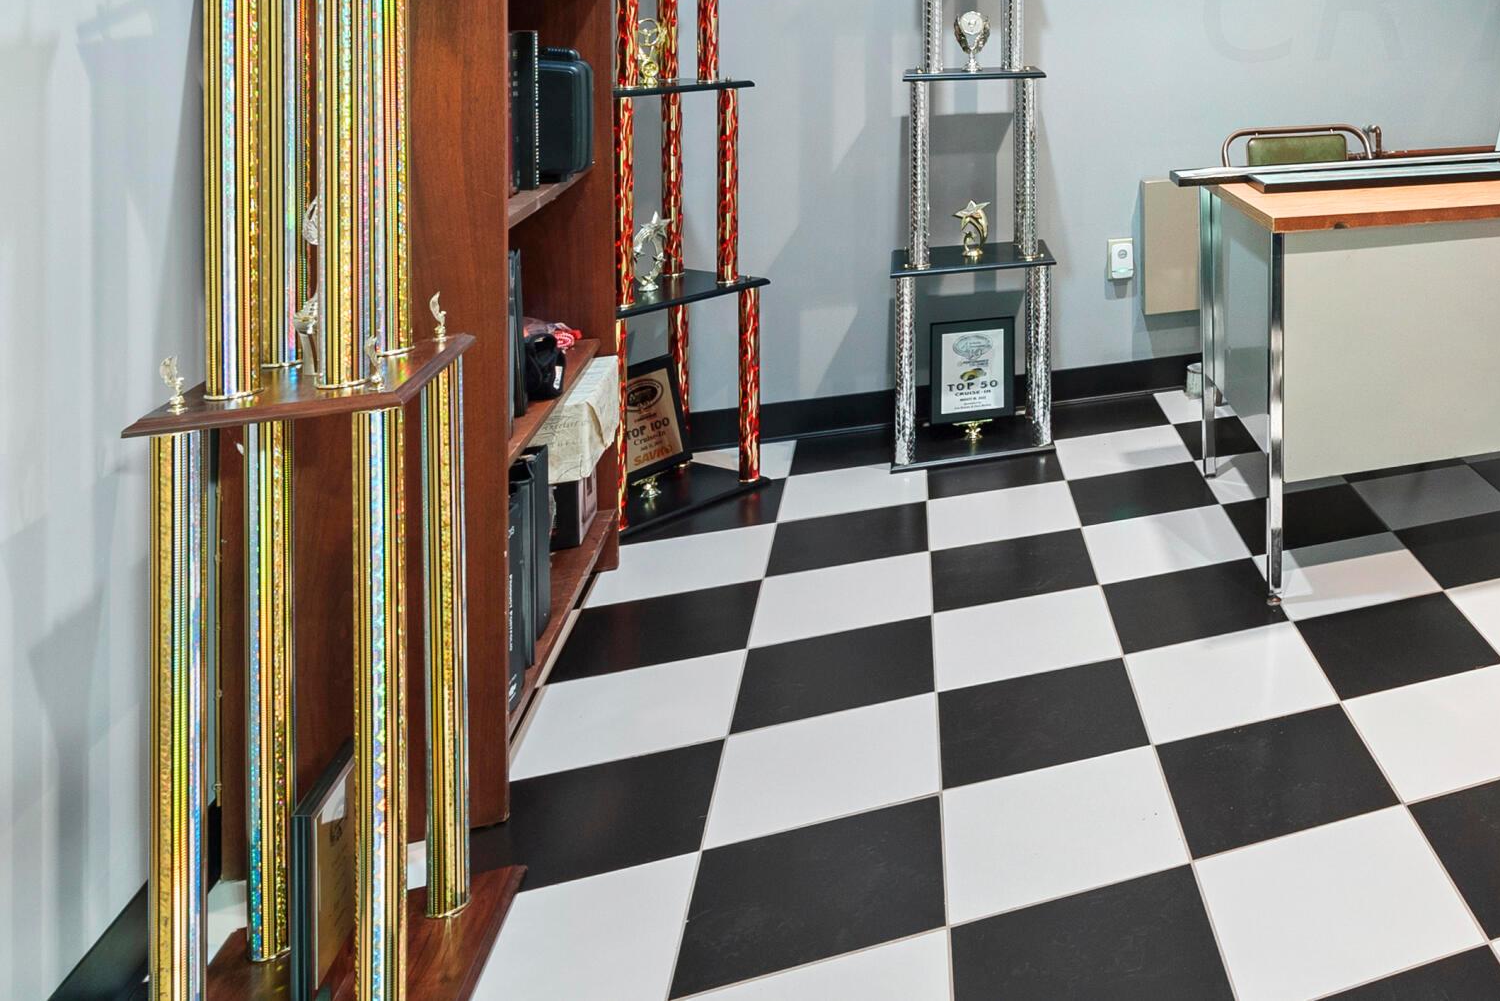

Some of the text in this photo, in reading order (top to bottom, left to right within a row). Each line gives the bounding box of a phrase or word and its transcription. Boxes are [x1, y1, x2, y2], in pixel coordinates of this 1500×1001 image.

[947, 379, 998, 392] TOP 50
[627, 417, 670, 440] TOP 100
